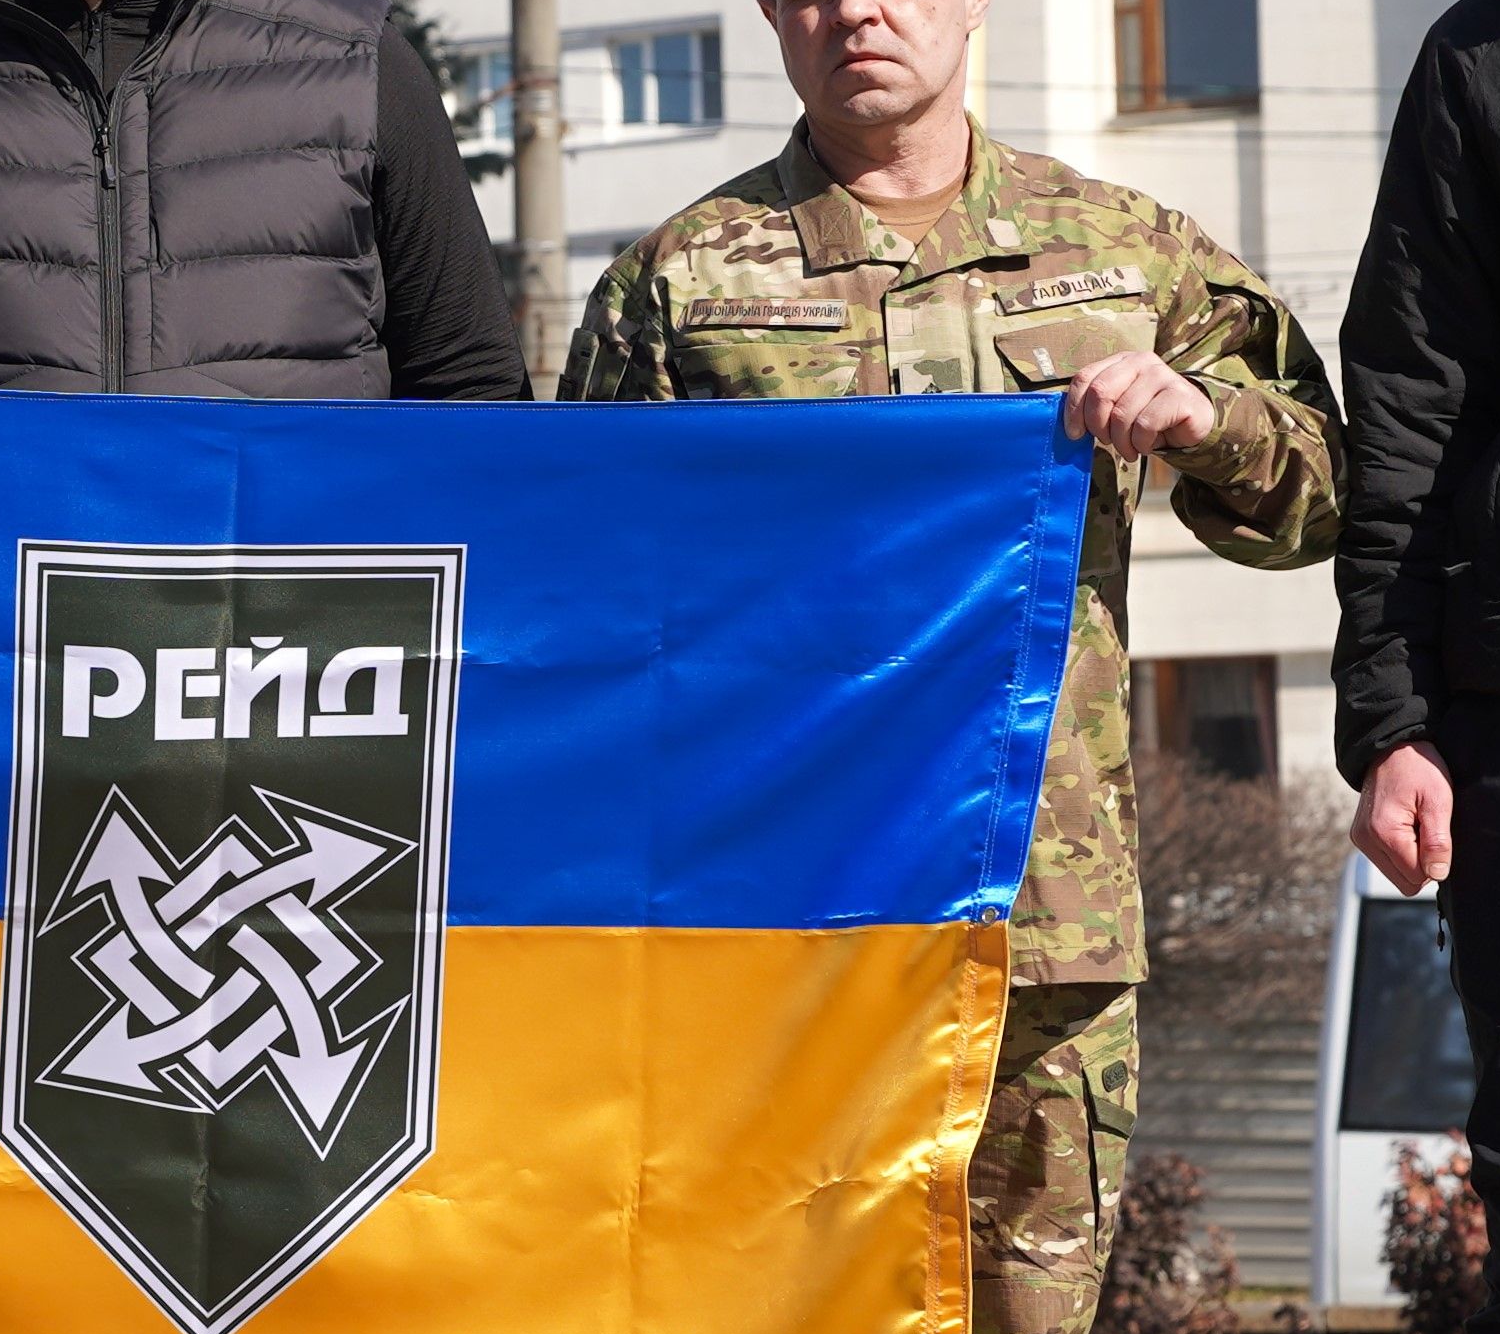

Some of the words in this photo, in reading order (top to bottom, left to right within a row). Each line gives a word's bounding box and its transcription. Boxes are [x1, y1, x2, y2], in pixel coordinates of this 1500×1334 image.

[1032, 276, 1113, 300] ГАЛУЩАК
[691, 305, 761, 317] НАЦІОНАЛЬНА
[762, 305, 801, 317] ГВАРДІЯ
[802, 304, 843, 318] УКРАЇНИ
[61, 635, 409, 741] РЕЙД
